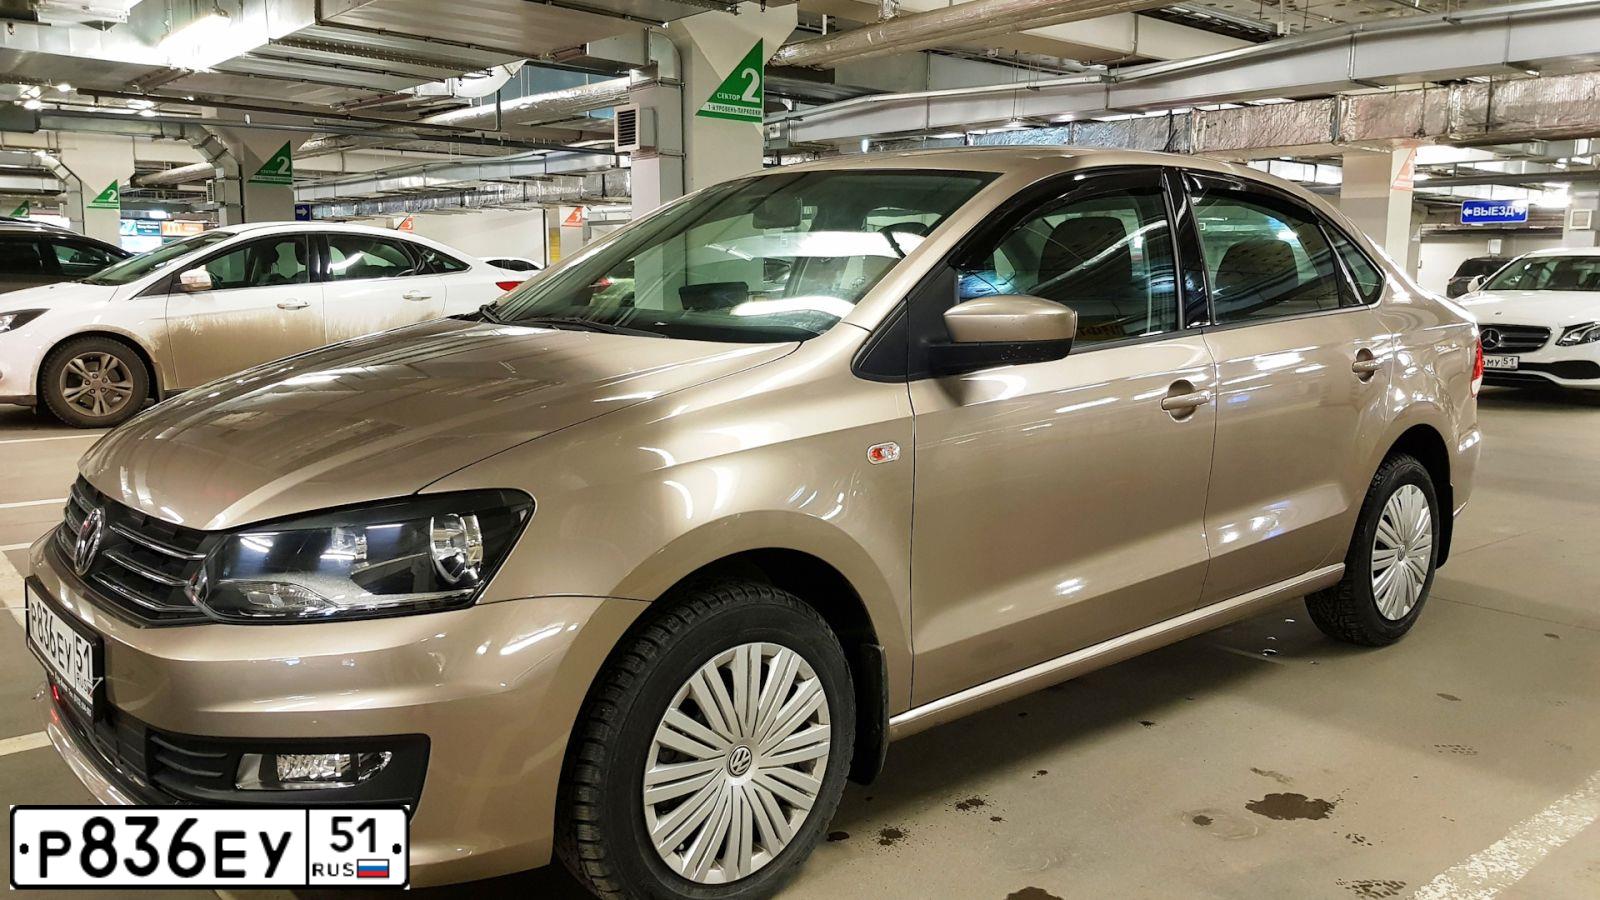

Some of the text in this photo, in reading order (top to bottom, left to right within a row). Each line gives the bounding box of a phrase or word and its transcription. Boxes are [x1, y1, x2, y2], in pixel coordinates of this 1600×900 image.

[716, 67, 760, 103] СЕКТОР 2
[276, 156, 291, 175] 2
[107, 189, 118, 203] 2
[1472, 205, 1515, 217] ВЫЕЗД
[31, 601, 91, 681] Р836ЕУ 51
